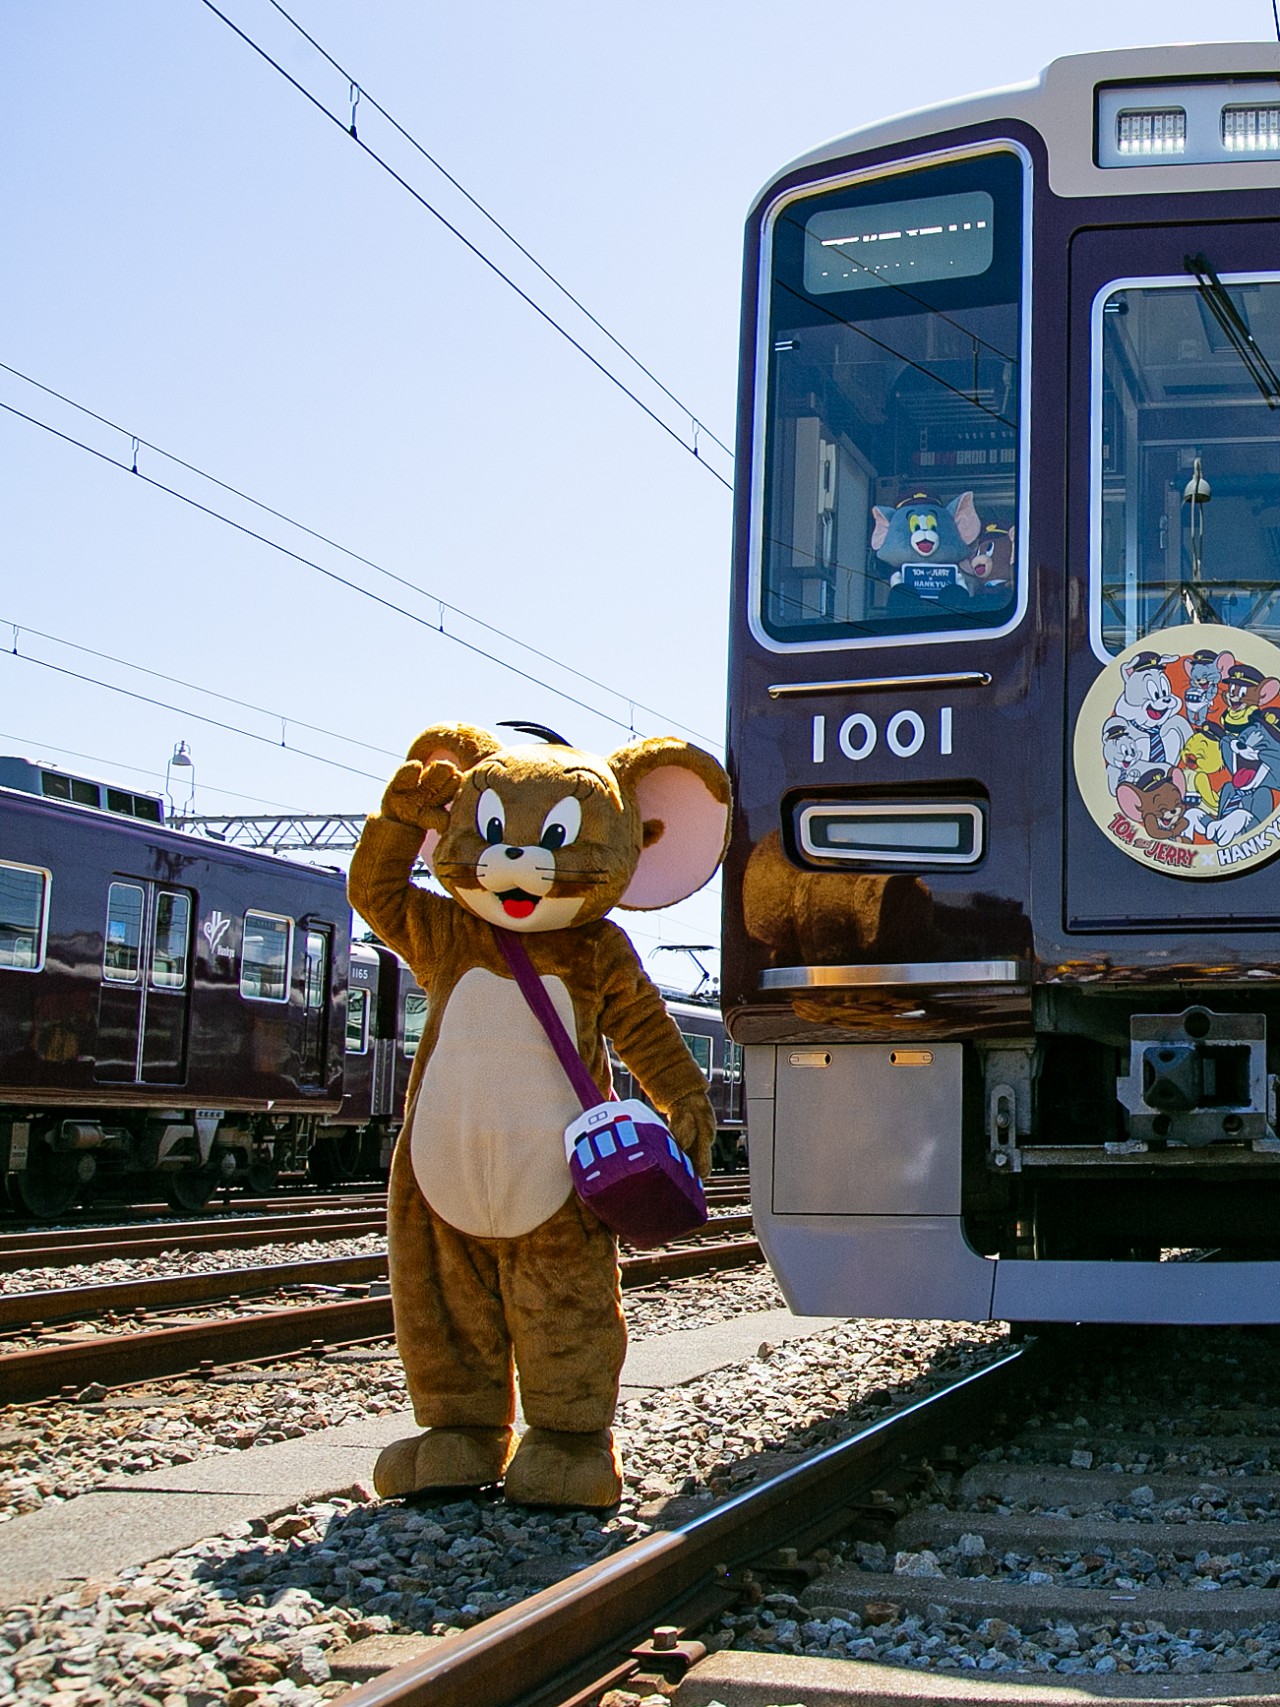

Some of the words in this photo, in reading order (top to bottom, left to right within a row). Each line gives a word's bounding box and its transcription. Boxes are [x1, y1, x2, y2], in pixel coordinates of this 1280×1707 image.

[813, 706, 953, 763] 1001
[1107, 811, 1138, 846] TOM
[1144, 840, 1199, 869] JERRY
[352, 967, 369, 980] 1165
